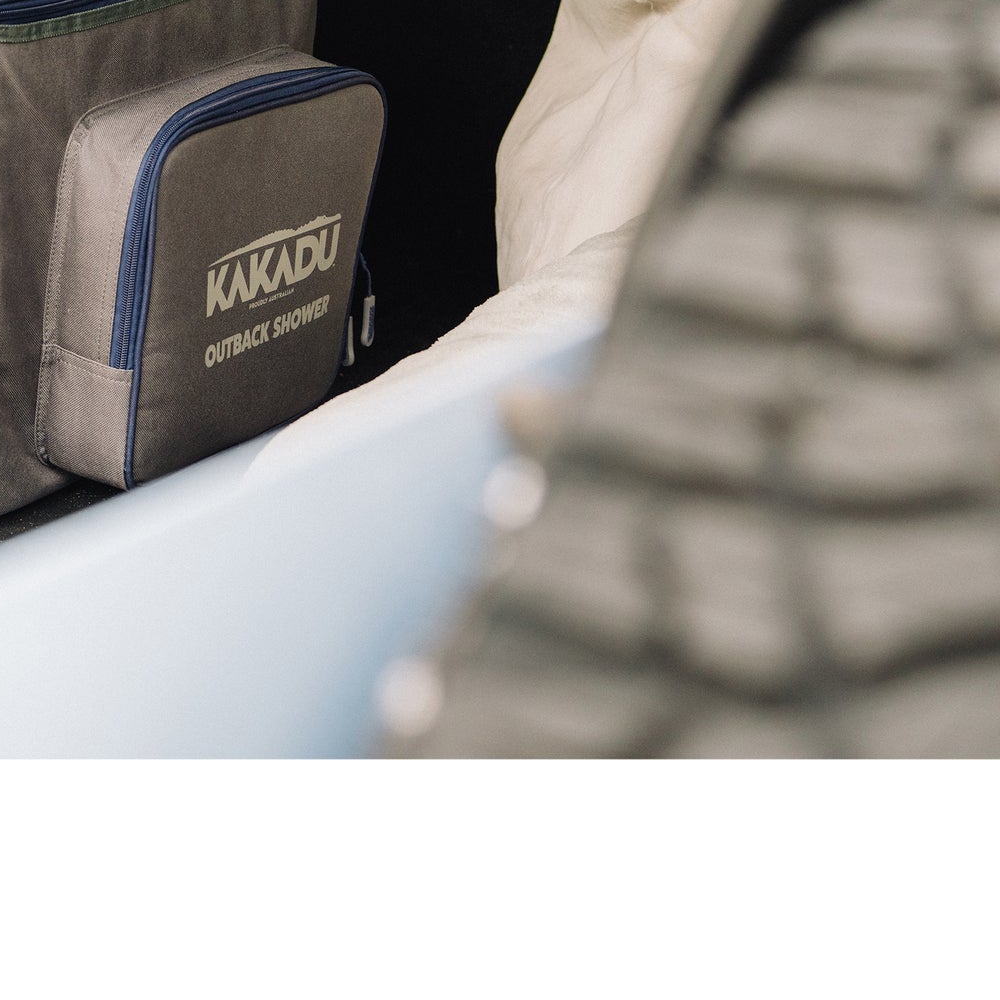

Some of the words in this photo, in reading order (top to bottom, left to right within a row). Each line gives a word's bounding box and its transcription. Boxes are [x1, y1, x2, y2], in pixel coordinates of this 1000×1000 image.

[206, 222, 341, 318] KAKADU
[204, 320, 271, 368] OUTBACK
[272, 294, 330, 339] SHOWER
